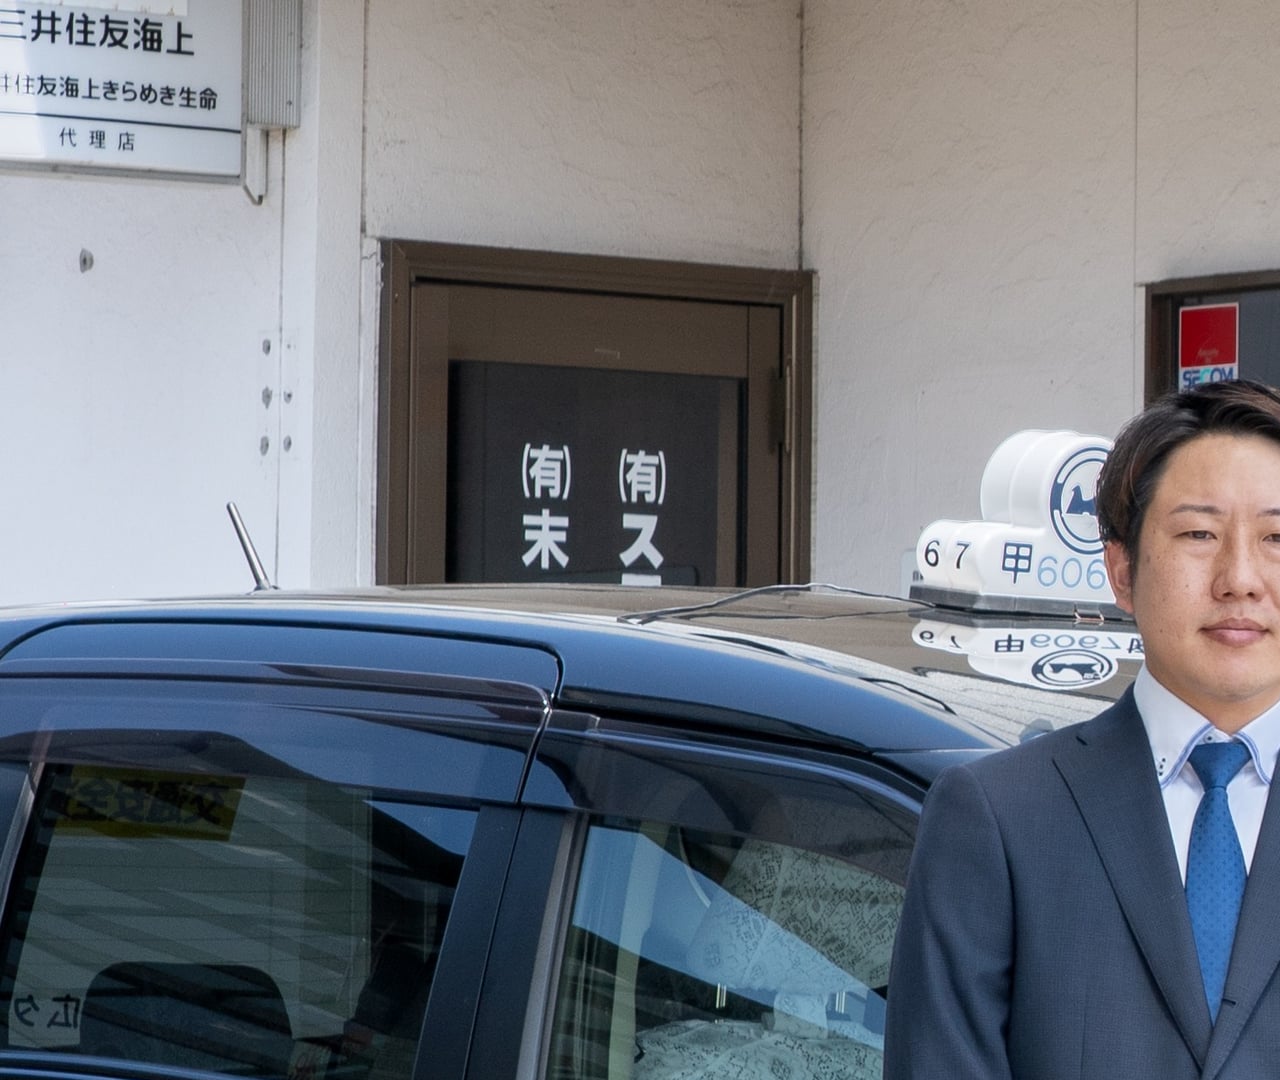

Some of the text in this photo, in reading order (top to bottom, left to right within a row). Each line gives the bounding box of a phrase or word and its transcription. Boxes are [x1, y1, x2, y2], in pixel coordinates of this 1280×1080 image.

[0, 9, 195, 57] 三井住友海上
[59, 127, 136, 152] 代理店
